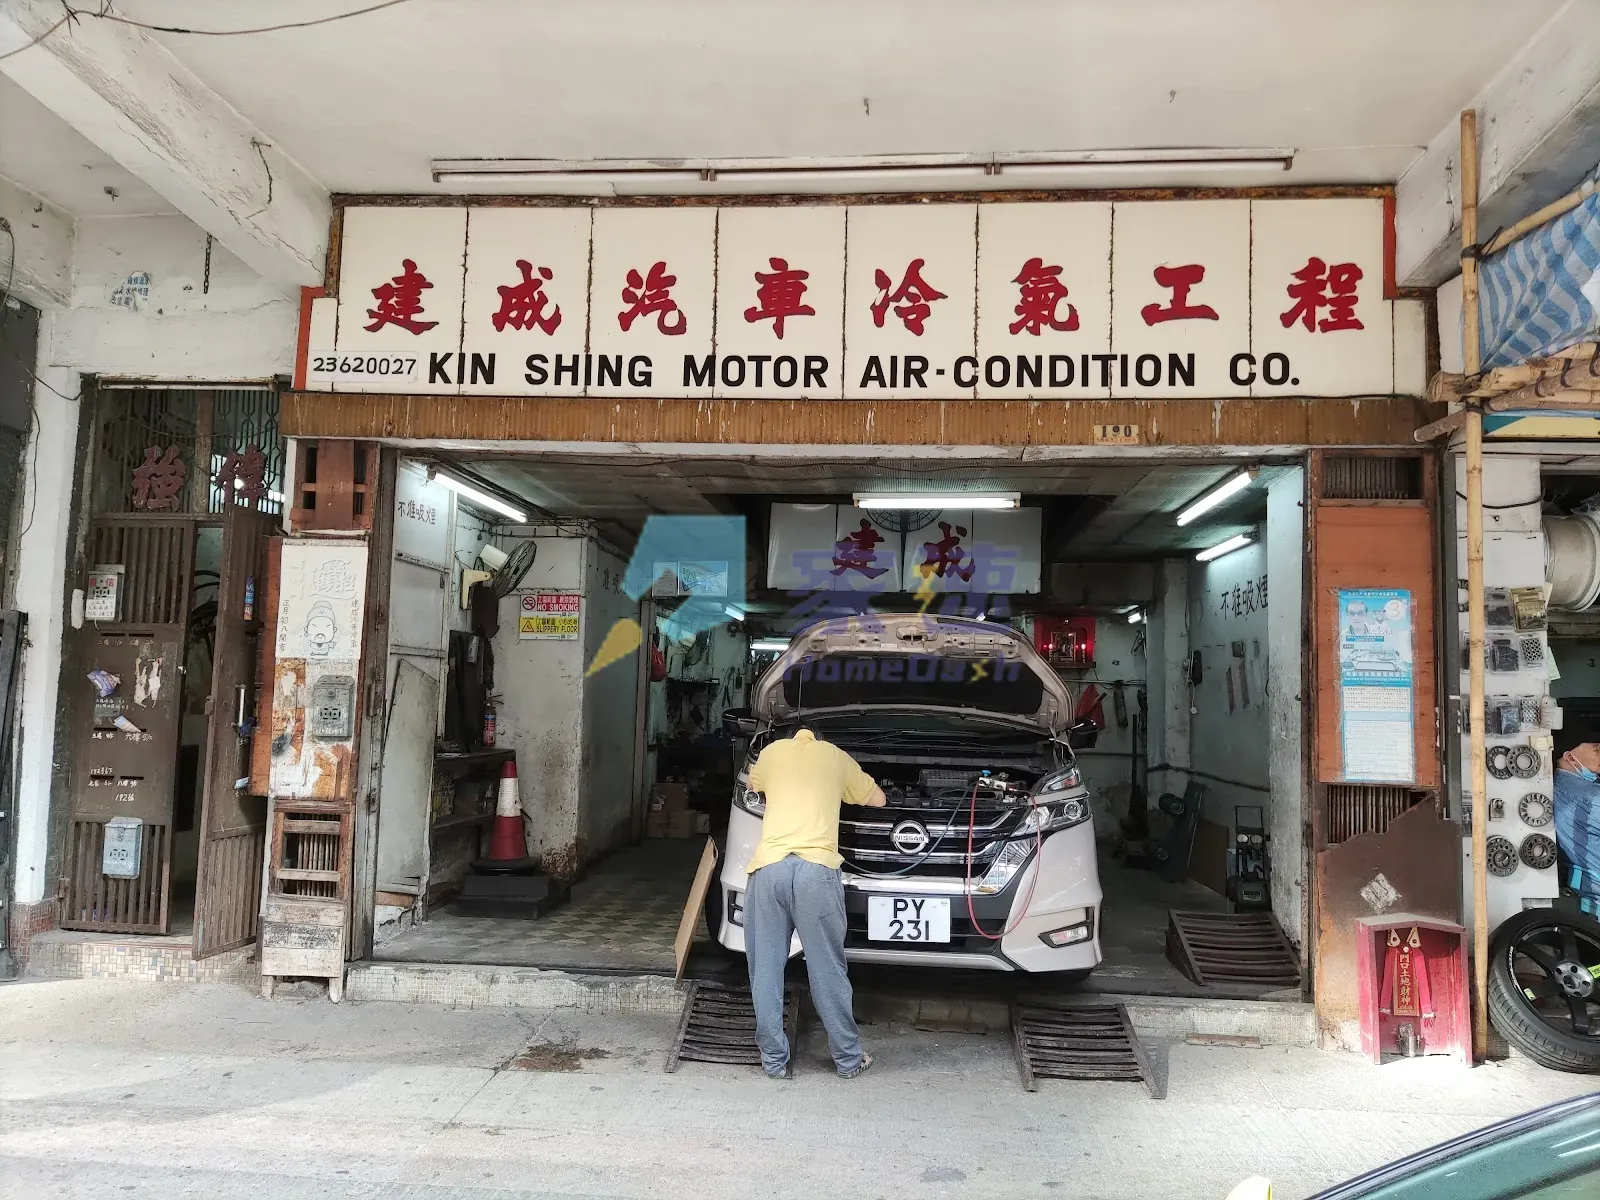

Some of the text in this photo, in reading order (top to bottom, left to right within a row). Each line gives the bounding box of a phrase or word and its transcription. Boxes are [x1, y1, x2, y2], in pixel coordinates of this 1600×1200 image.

[363, 257, 1365, 340] 建成汽車冷氣工程
[312, 356, 417, 376] 23620027
[429, 352, 1300, 388] KIN SHING MOTOR AIR-CONDITION CO.
[829, 518, 976, 582] 建成
[894, 833, 926, 842] NISSAN
[893, 898, 926, 919] PY
[888, 919, 930, 941] 231
